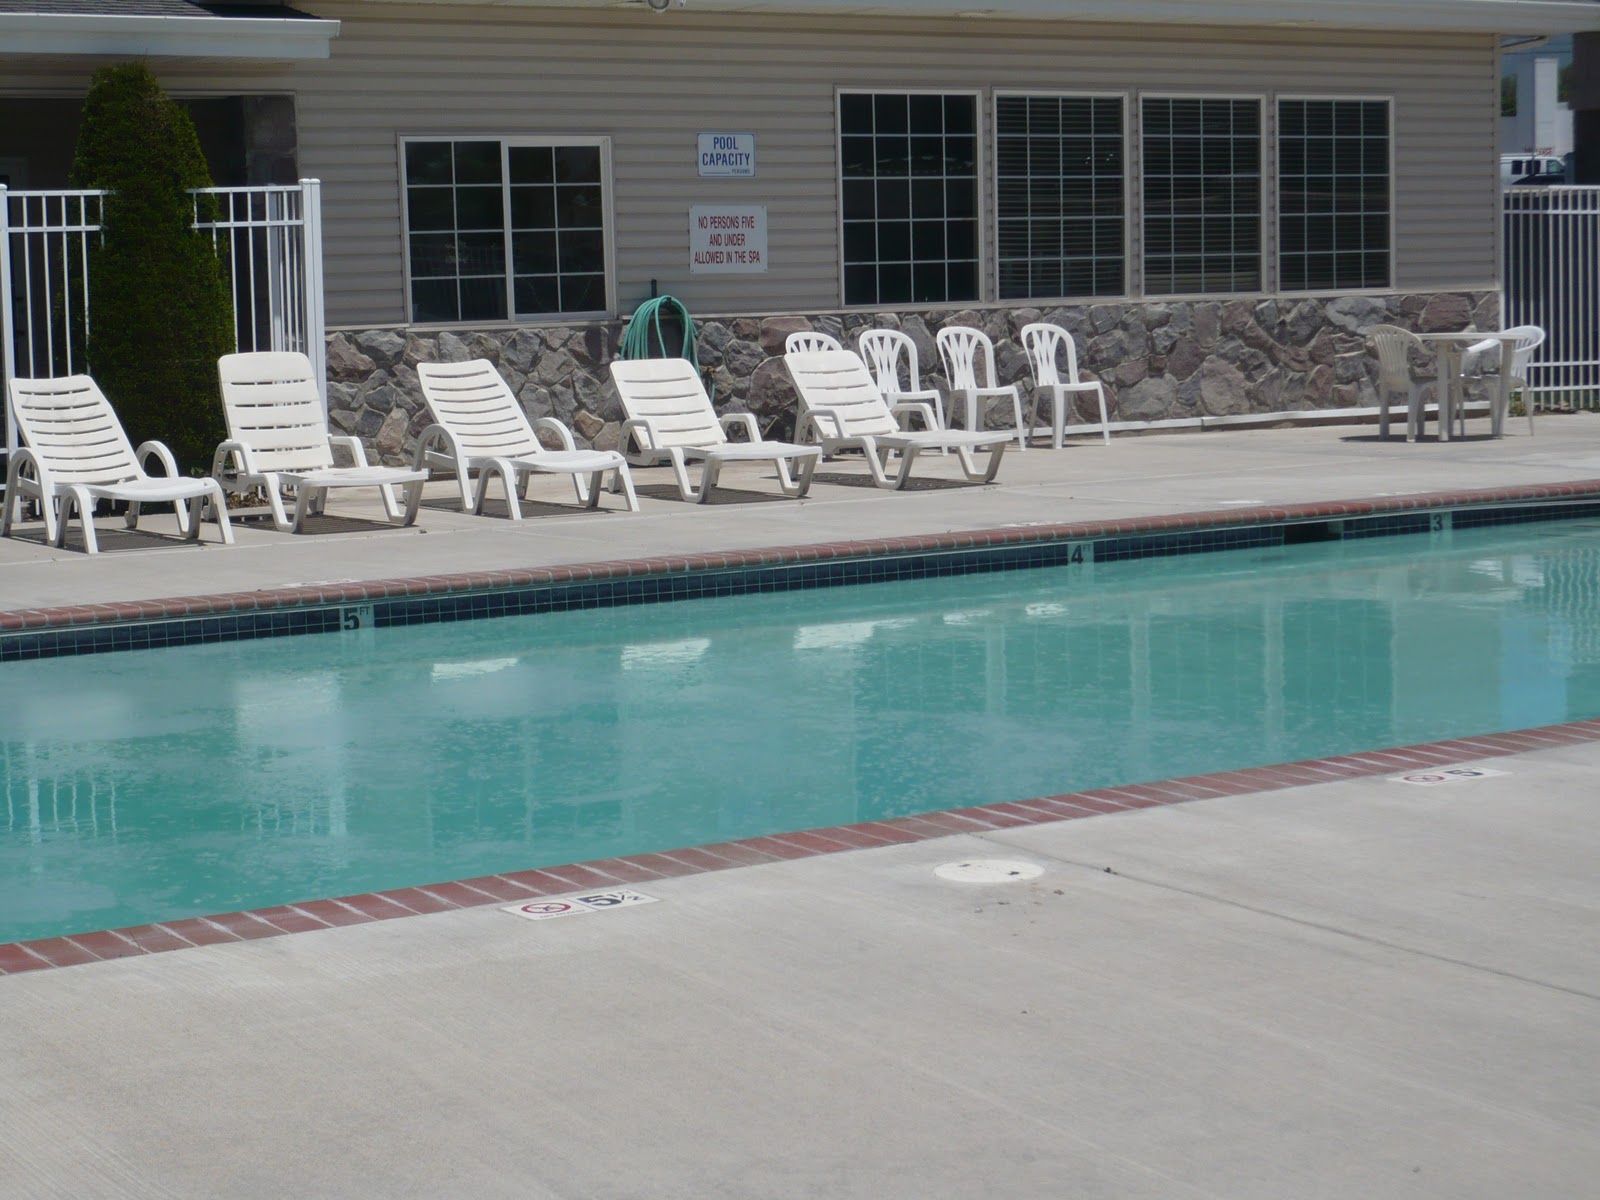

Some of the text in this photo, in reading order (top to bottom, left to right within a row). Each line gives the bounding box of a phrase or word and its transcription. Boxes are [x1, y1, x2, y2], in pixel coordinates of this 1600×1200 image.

[713, 136, 739, 150] POOL
[702, 152, 750, 166] CAPACITY
[698, 216, 755, 229] NO PERSONS FIVE
[709, 233, 746, 246] AND UNDER
[694, 250, 760, 264] ALLOWED IN THE SPA
[1433, 513, 1443, 531] 3
[1071, 544, 1084, 564] 4
[344, 606, 370, 630] 5 FT
